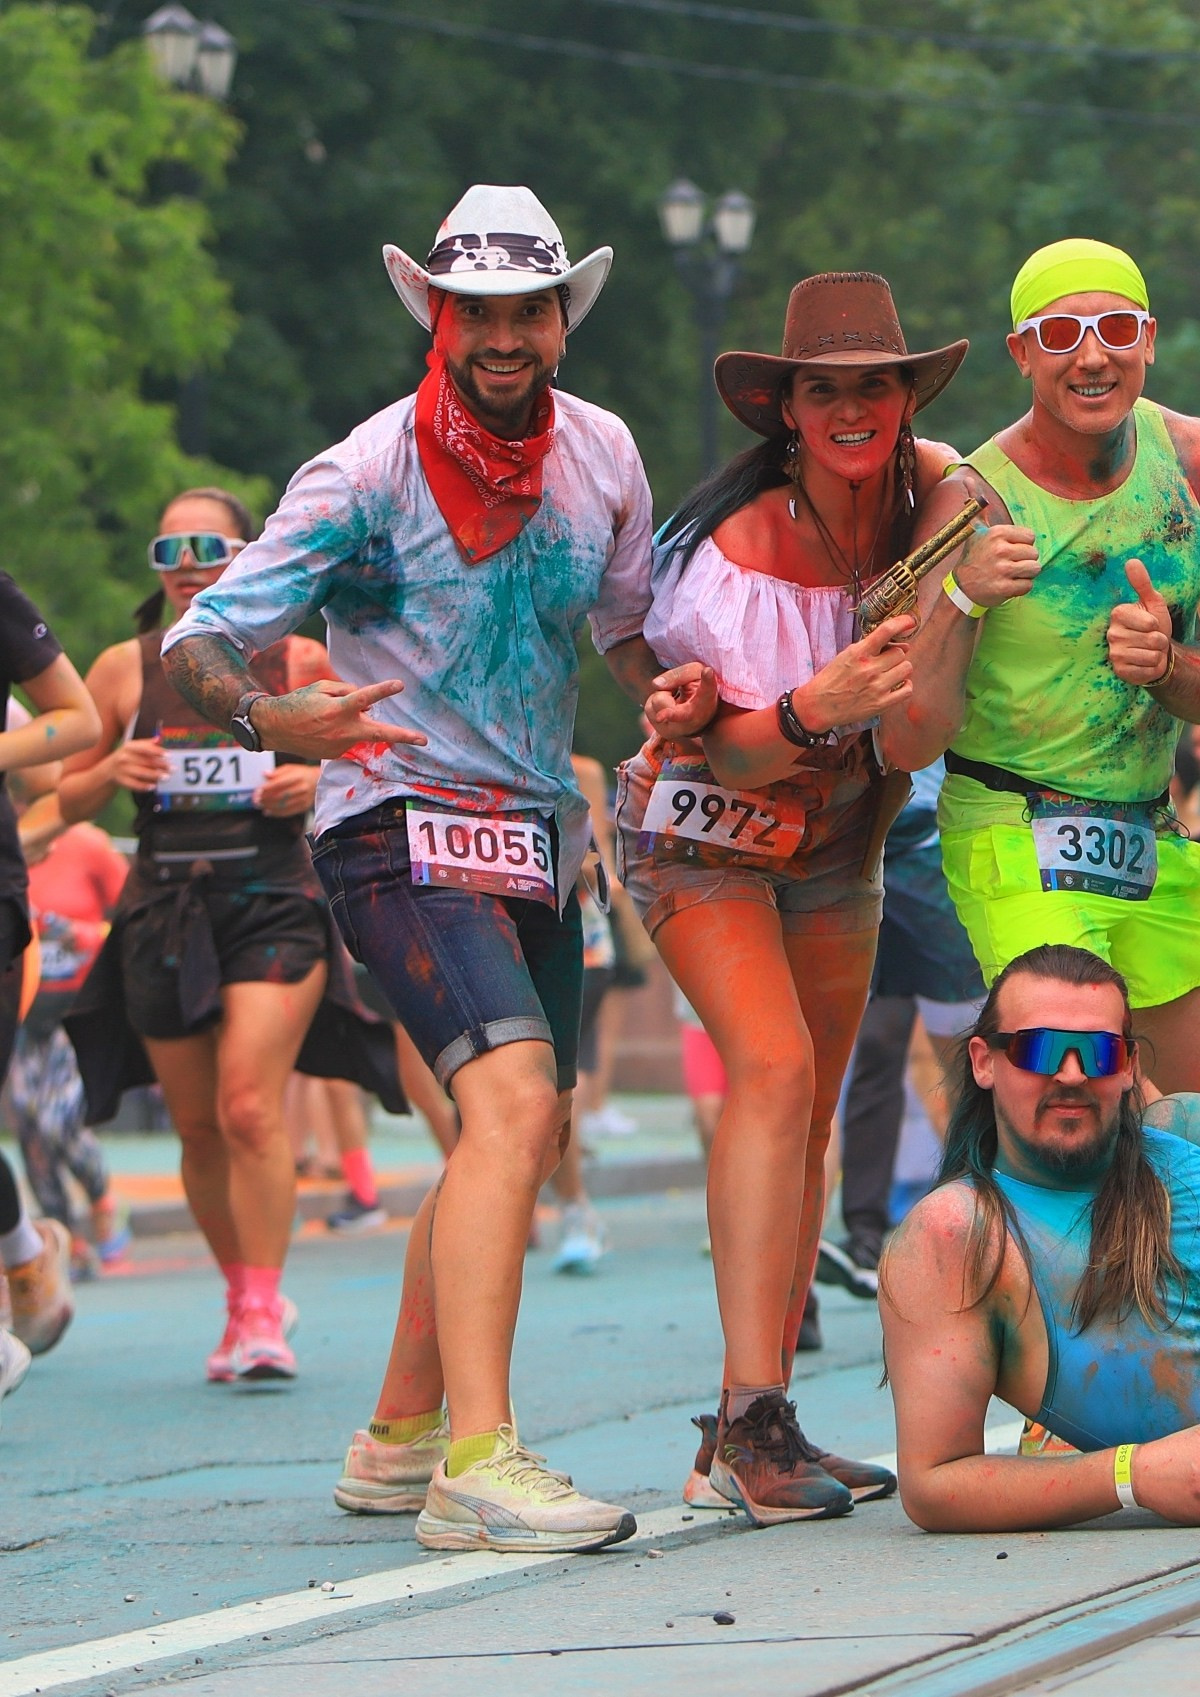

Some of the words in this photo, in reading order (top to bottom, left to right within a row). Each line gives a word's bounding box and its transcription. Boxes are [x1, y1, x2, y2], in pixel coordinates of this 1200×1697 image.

[183, 754, 242, 786] 521
[671, 789, 783, 848] 9972
[418, 820, 549, 873] 10055
[1057, 824, 1145, 875] 3302
